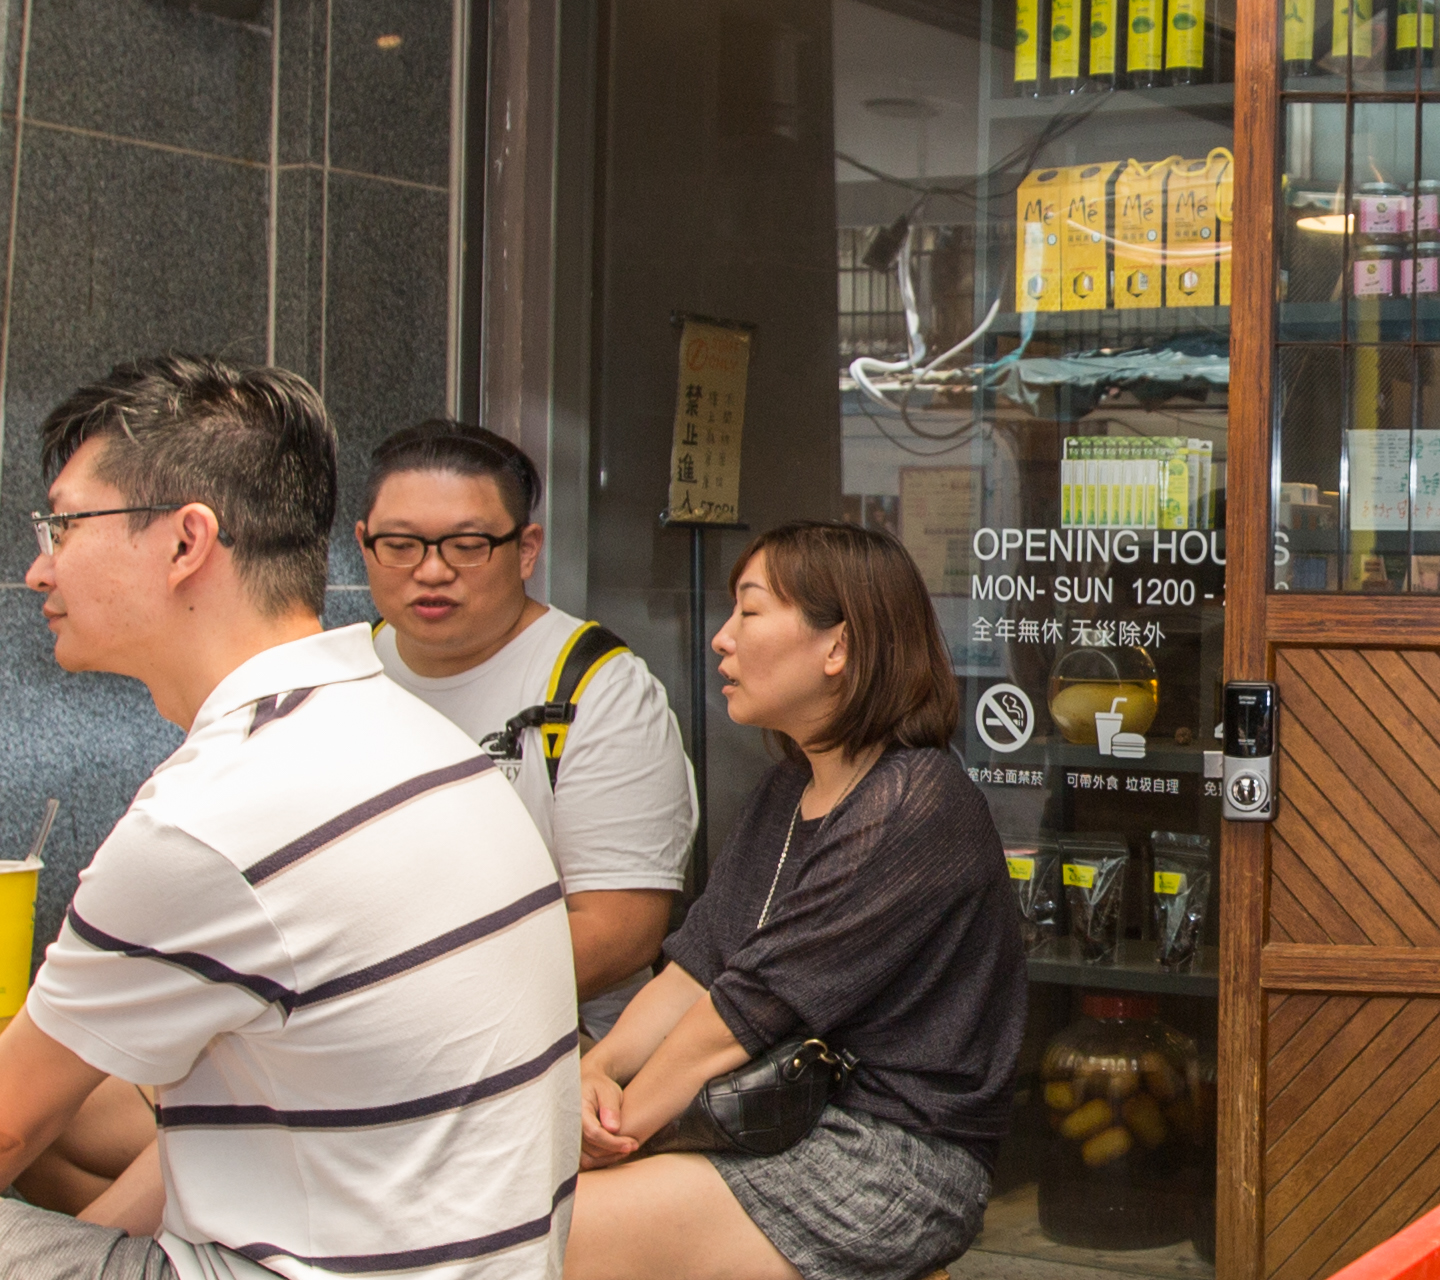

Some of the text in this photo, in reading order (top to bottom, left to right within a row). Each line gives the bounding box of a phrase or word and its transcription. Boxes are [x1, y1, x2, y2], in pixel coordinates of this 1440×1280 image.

[973, 528, 1290, 566] OPENING HOUS
[1053, 575, 1113, 604] SUN
[1132, 578, 1196, 605] 1200
[971, 616, 1166, 649] 全年無休 天災除外
[967, 767, 1043, 787] 室內全面禁菸
[1066, 772, 1180, 795] 可帶外食 垃圾自理
